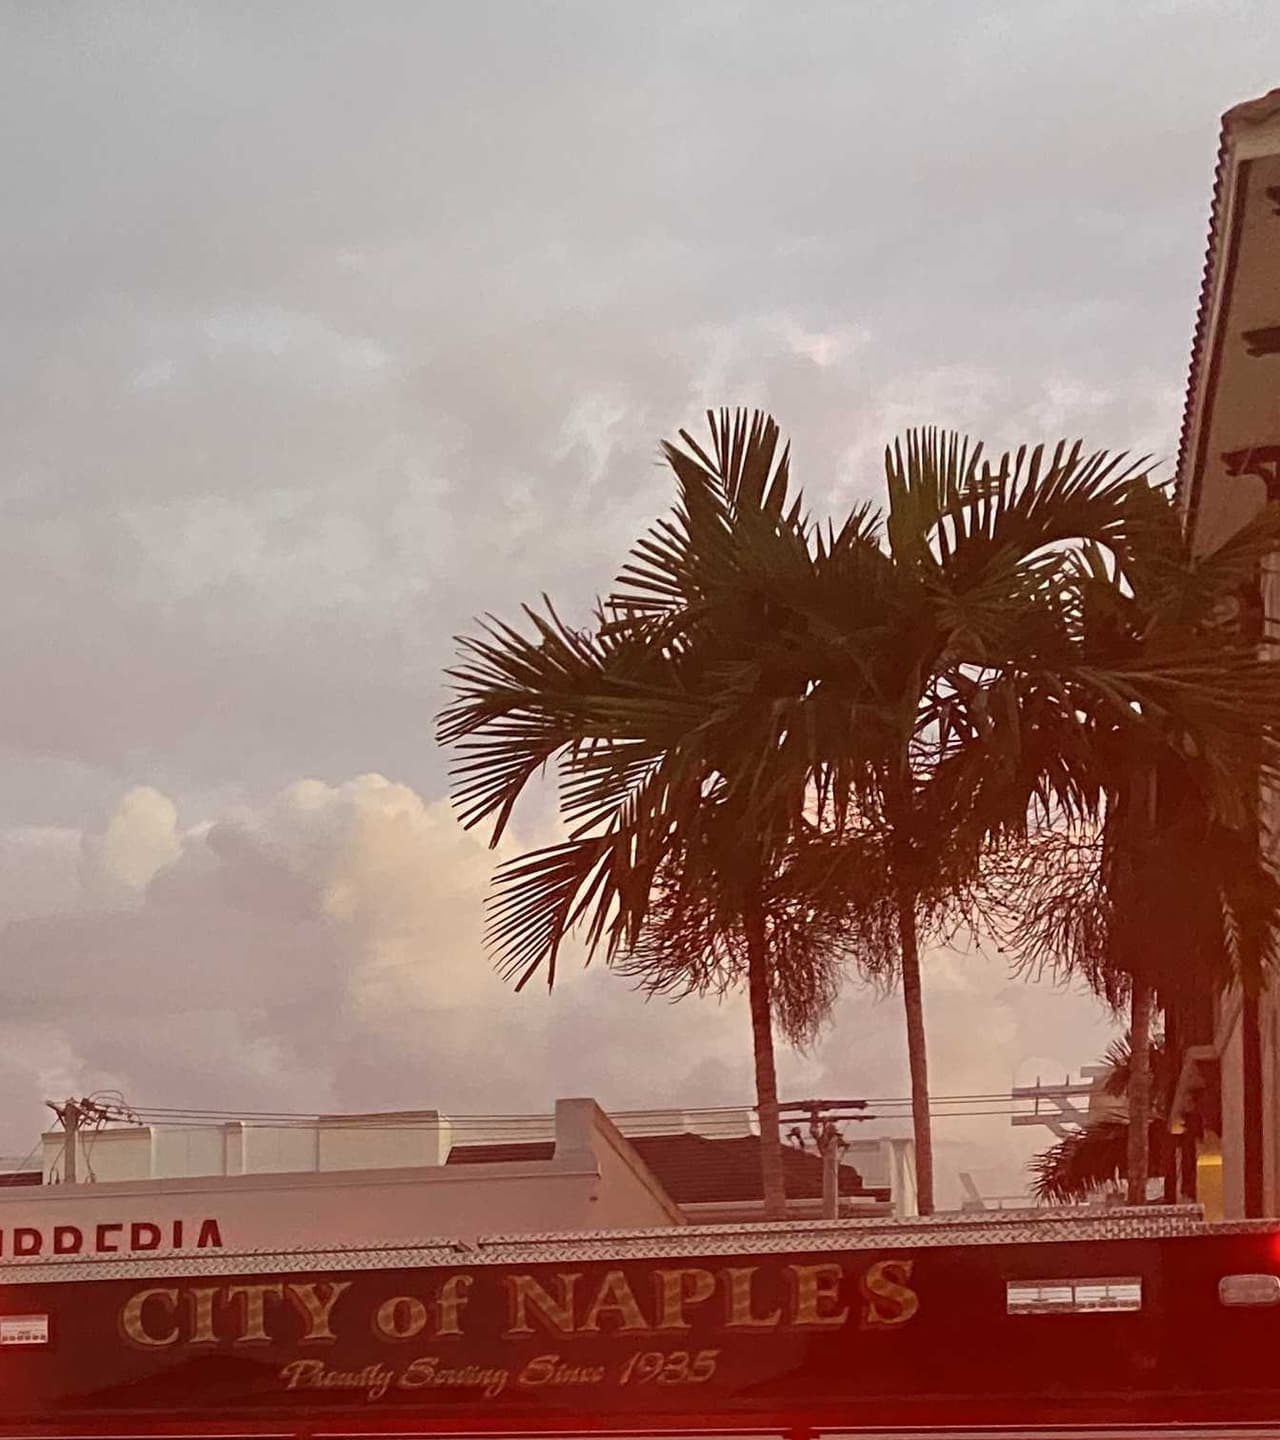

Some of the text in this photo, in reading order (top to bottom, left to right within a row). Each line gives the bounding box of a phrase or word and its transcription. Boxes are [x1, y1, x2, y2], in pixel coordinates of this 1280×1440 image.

[120, 1259, 920, 1348] CITY of NAPLES
[281, 1350, 721, 1399] Proudly Serving Since 1935
